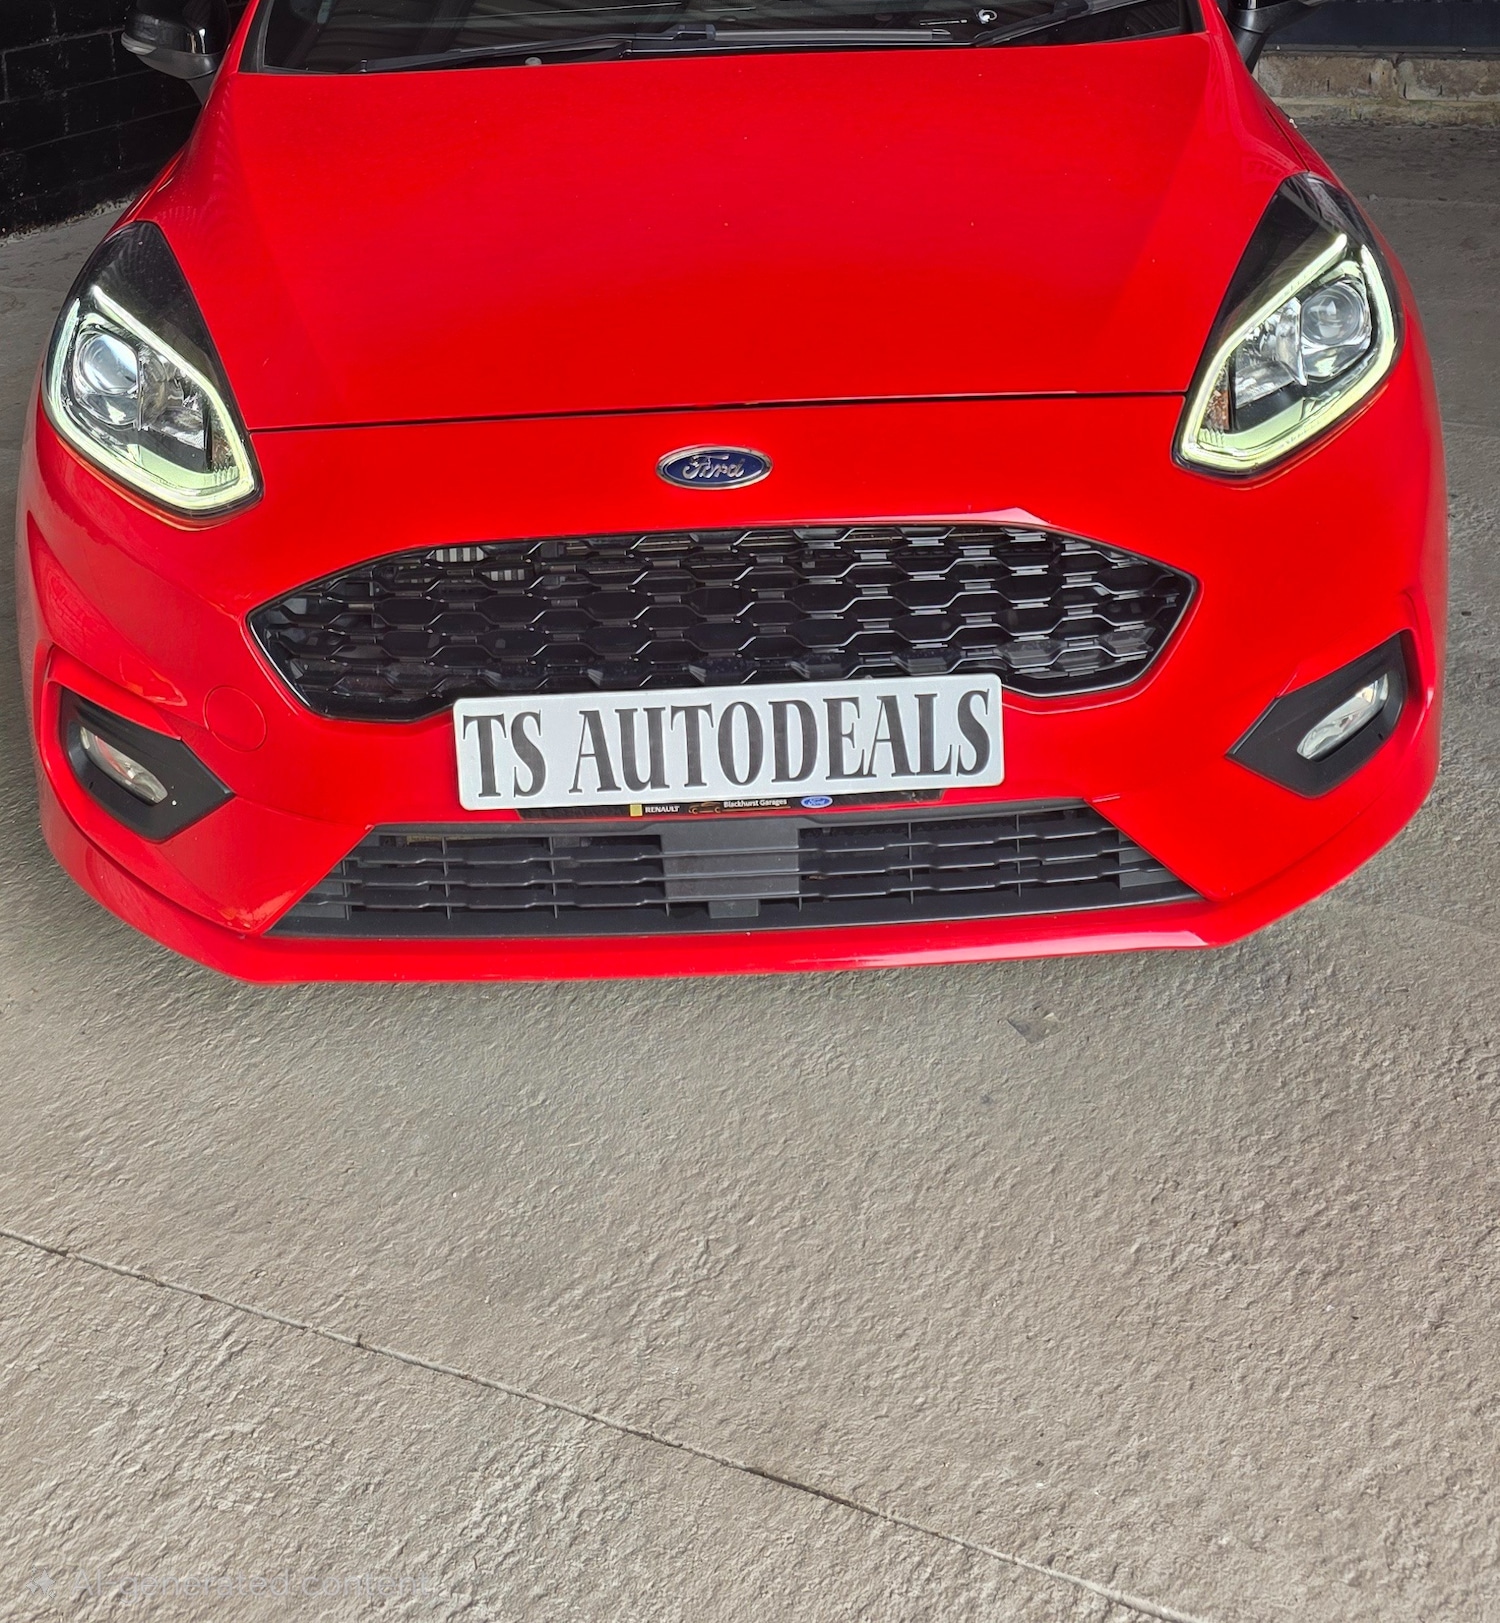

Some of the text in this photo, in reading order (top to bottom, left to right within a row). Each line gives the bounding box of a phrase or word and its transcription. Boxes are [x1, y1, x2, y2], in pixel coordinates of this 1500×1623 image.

[682, 454, 745, 479] Ford
[463, 688, 991, 797] TS AUTODEALS
[644, 805, 680, 814] RENAULT
[723, 797, 788, 808] Blackhurst Garages
